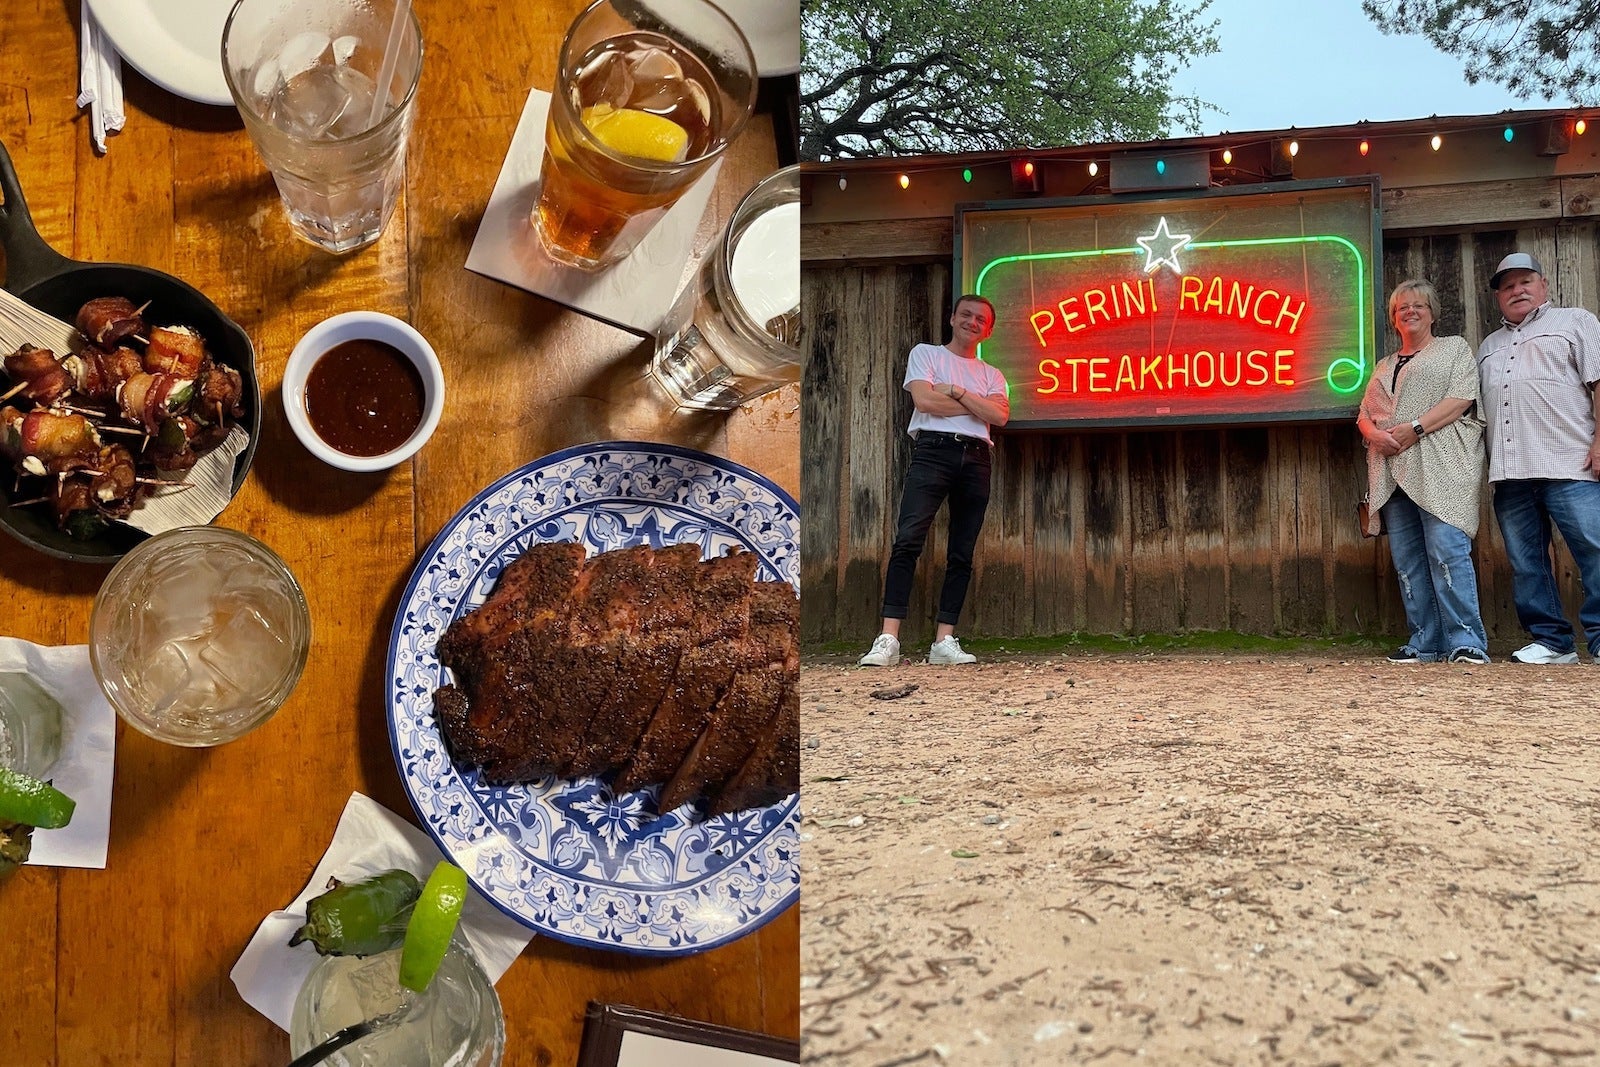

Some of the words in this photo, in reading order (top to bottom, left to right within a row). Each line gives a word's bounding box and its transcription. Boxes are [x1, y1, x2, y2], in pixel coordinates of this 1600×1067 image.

[1030, 278, 1158, 347] PERINI
[1179, 276, 1306, 334] RANCH
[1036, 349, 1295, 394] STEAKHOUSE
